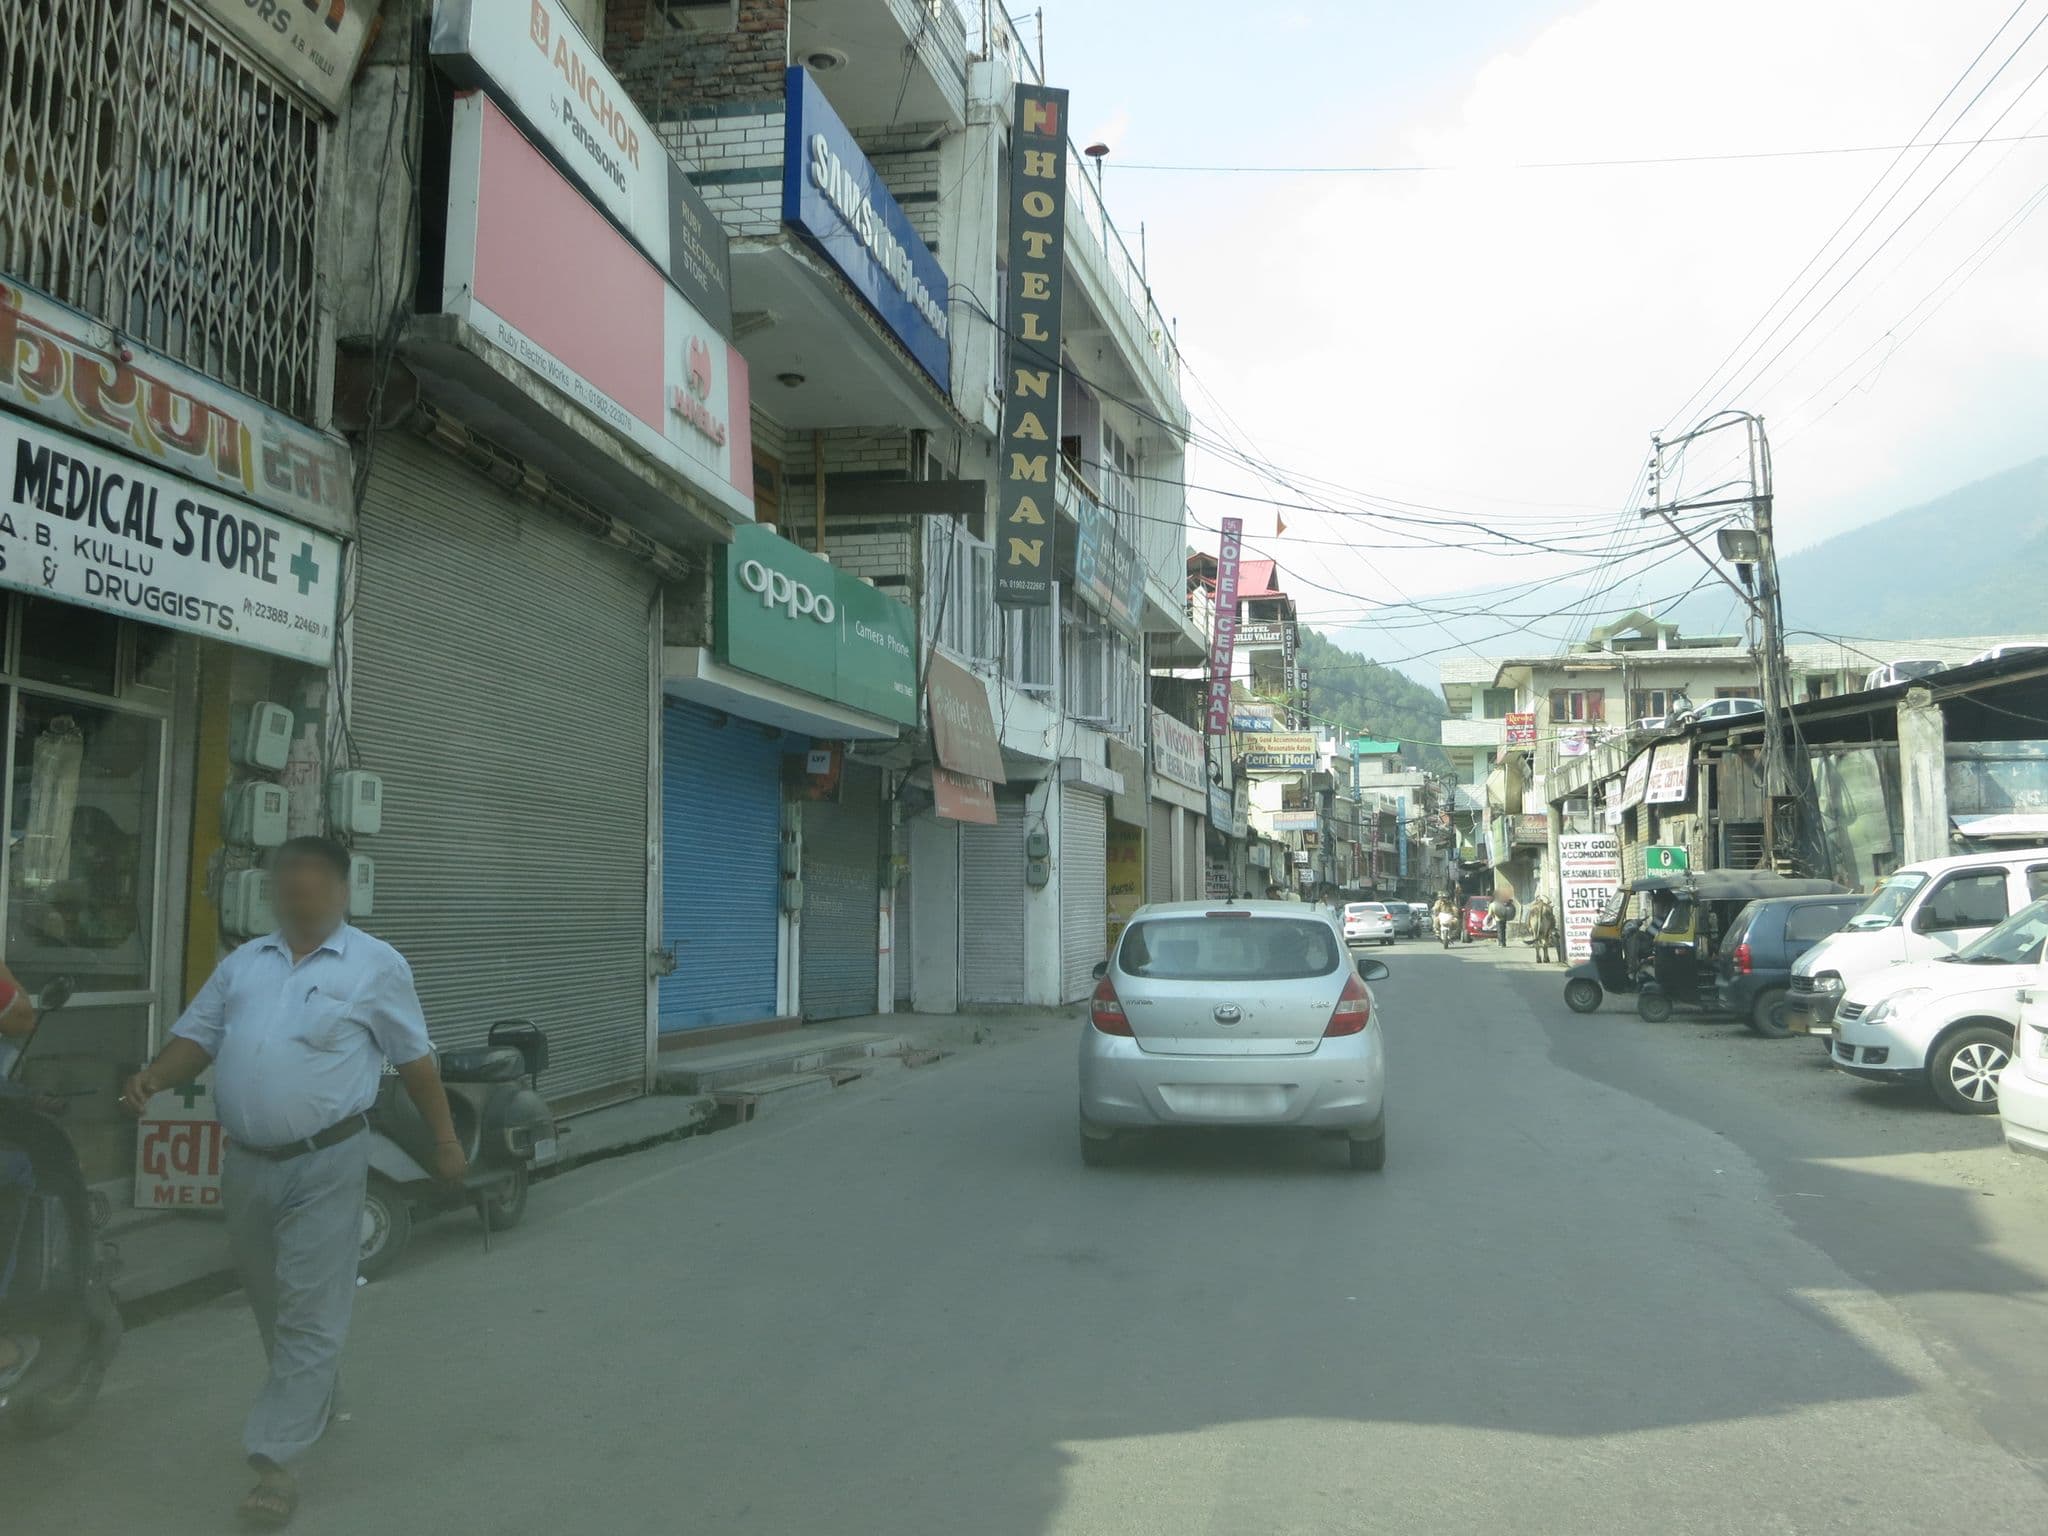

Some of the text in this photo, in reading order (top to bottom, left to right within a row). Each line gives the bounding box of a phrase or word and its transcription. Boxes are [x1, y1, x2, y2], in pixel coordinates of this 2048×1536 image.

[310, 48, 335, 77] KULLU
[553, 33, 640, 171] ANCHOR
[549, 97, 627, 194] by Panasonic
[682, 199, 702, 239] RUBY
[811, 133, 907, 293] SAMSUNG
[683, 224, 725, 292] ELECTRICAL
[683, 250, 709, 294] STORE
[498, 323, 519, 350] Ruby
[520, 339, 547, 370] Electric
[548, 359, 570, 387] Works
[1007, 150, 1056, 568] HOTEL NAMAN
[13, 437, 164, 549] MEDICAL
[172, 498, 280, 585] STORE
[73, 534, 154, 577] KULLU
[42, 556, 58, 589] &
[85, 568, 240, 633] DRUGGISTS.
[739, 558, 910, 658] oppo Camera Phone
[1210, 531, 1240, 731] HOTEL CENTRAL
[1233, 632, 1281, 641] ULLU VALLEY
[1285, 628, 1293, 661] HOTEL
[1246, 753, 1314, 765] Central Hotel
[1561, 840, 1618, 850] VERY GOOD
[1561, 850, 1619, 859] ACCOMODATION
[1562, 869, 1620, 879] REASONABLE RATES
[1571, 887, 1612, 898] HOTEL
[1566, 916, 1592, 924] CLEAN
